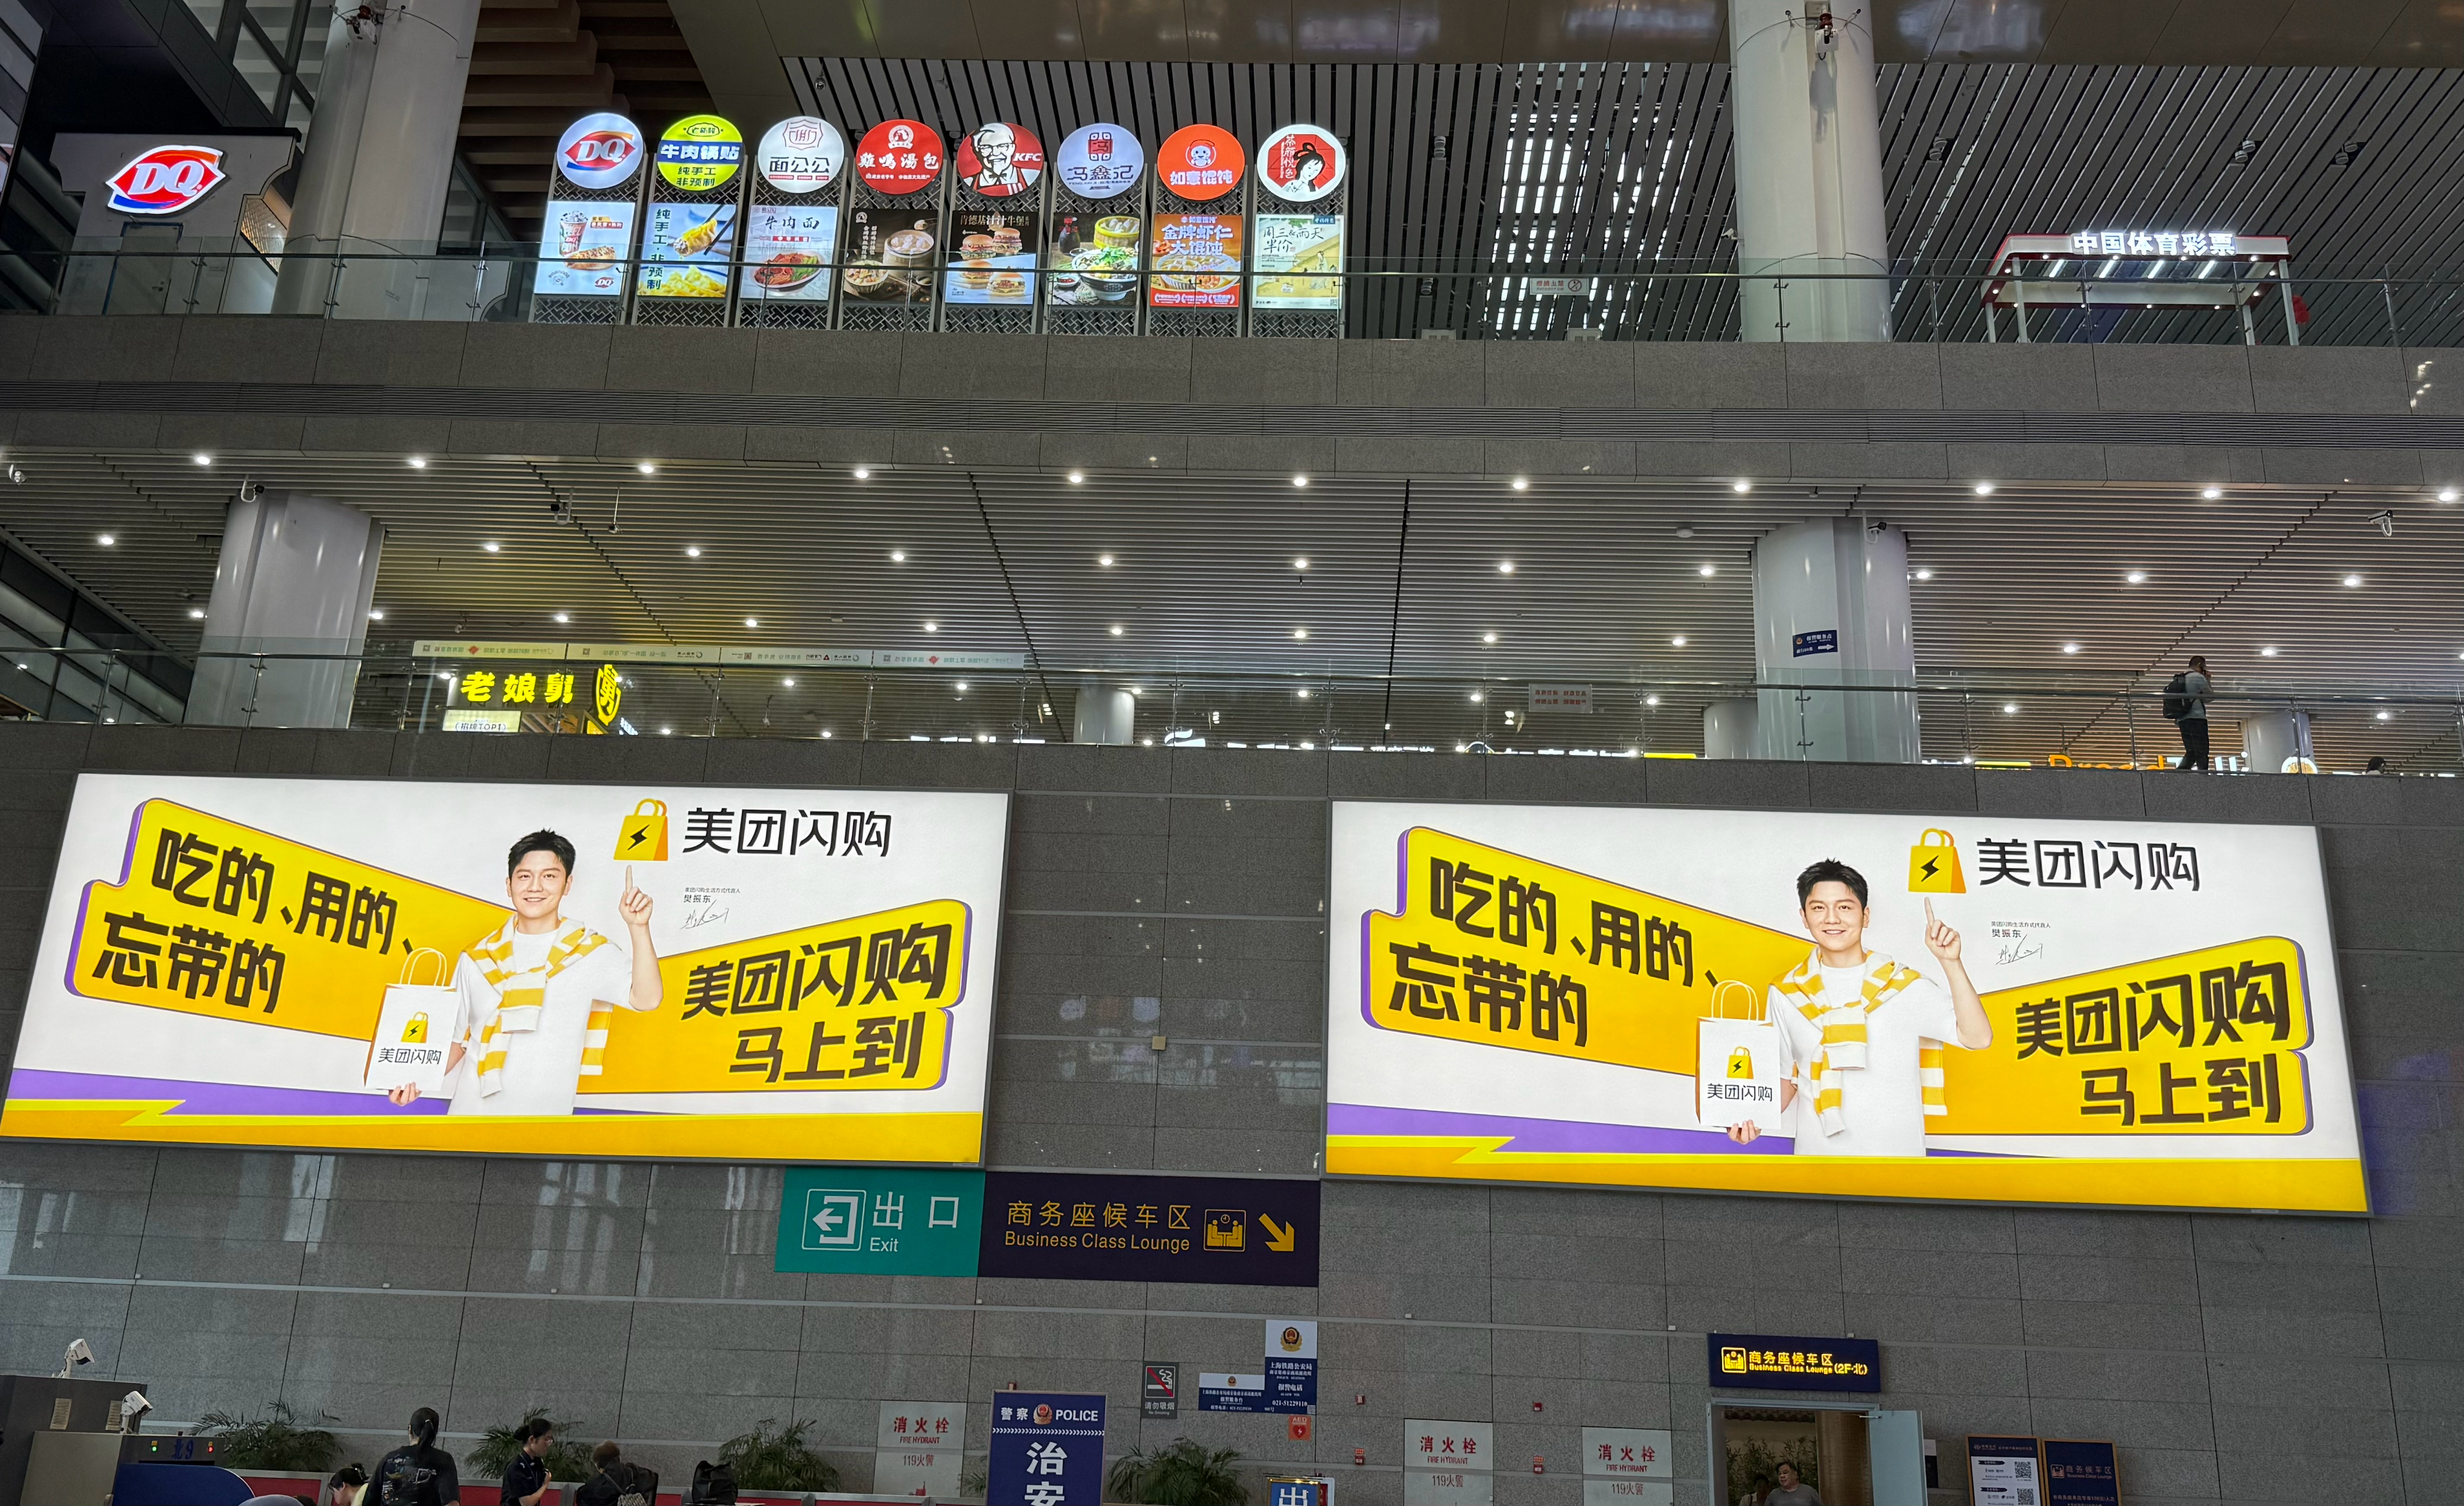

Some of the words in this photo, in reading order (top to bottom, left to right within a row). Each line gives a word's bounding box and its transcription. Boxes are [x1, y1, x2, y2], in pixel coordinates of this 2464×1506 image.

[576, 139, 625, 163] DQ
[661, 145, 740, 160] 牛肉锅贴
[1013, 153, 1042, 161] KFC
[678, 167, 716, 175] 纯手工
[770, 157, 830, 173] 面公公
[128, 161, 205, 196] DQ
[677, 178, 715, 186] 非预制
[1170, 170, 1233, 185] 如意馄饨
[765, 216, 819, 230] 牛肉面
[1161, 224, 1233, 240] 金牌虾仁
[1170, 240, 1223, 256] 大馄饨
[1264, 239, 1293, 253] 半价
[2073, 231, 2236, 257] 中国体育彩票
[460, 671, 575, 703] 老娘舅
[682, 807, 891, 857] 美团闪购
[1976, 837, 2201, 892] 美团闪购
[683, 894, 711, 903] 樊振东
[1992, 929, 2021, 938] 樊振东
[92, 911, 286, 1014] 忘带的
[681, 921, 952, 1021] 美团闪购
[1389, 942, 1588, 1047] 忘带的
[2015, 960, 2291, 1060] 美团闪购
[729, 1011, 926, 1083] 马上到
[378, 1047, 441, 1066] 美团闪购
[1707, 1083, 1773, 1103] 美团闪购
[2080, 1053, 2282, 1127] 马上到
[872, 1192, 960, 1231] 出口
[1007, 1201, 1191, 1231] 商务座候车区
[870, 1237, 899, 1253] Exit
[1004, 1231, 1077, 1248] Business
[1082, 1233, 1127, 1250] Class
[1131, 1234, 1190, 1254] Lounge
[1271, 1362, 1312, 1370] 上海铁路公安局
[1749, 1351, 1833, 1366] 商务座候车区
[1749, 1363, 1781, 1371] Business
[1784, 1365, 1804, 1373] Class
[1806, 1365, 1833, 1375] Lounge
[1001, 1407, 1028, 1421] 警察
[1145, 1402, 1174, 1410] 请勿吸烟
[1056, 1409, 1098, 1421] POLICE
[894, 1416, 949, 1434] 消火栓
[1420, 1436, 1476, 1454] 消火栓
[1599, 1444, 1655, 1462] 消火栓
[904, 1454, 934, 1466] 119火警
[1441, 1456, 1468, 1465] HYDRANT
[1024, 1442, 1067, 1506] 治安
[1432, 1475, 1463, 1487] 119火警
[1611, 1483, 1643, 1495] 119火警
